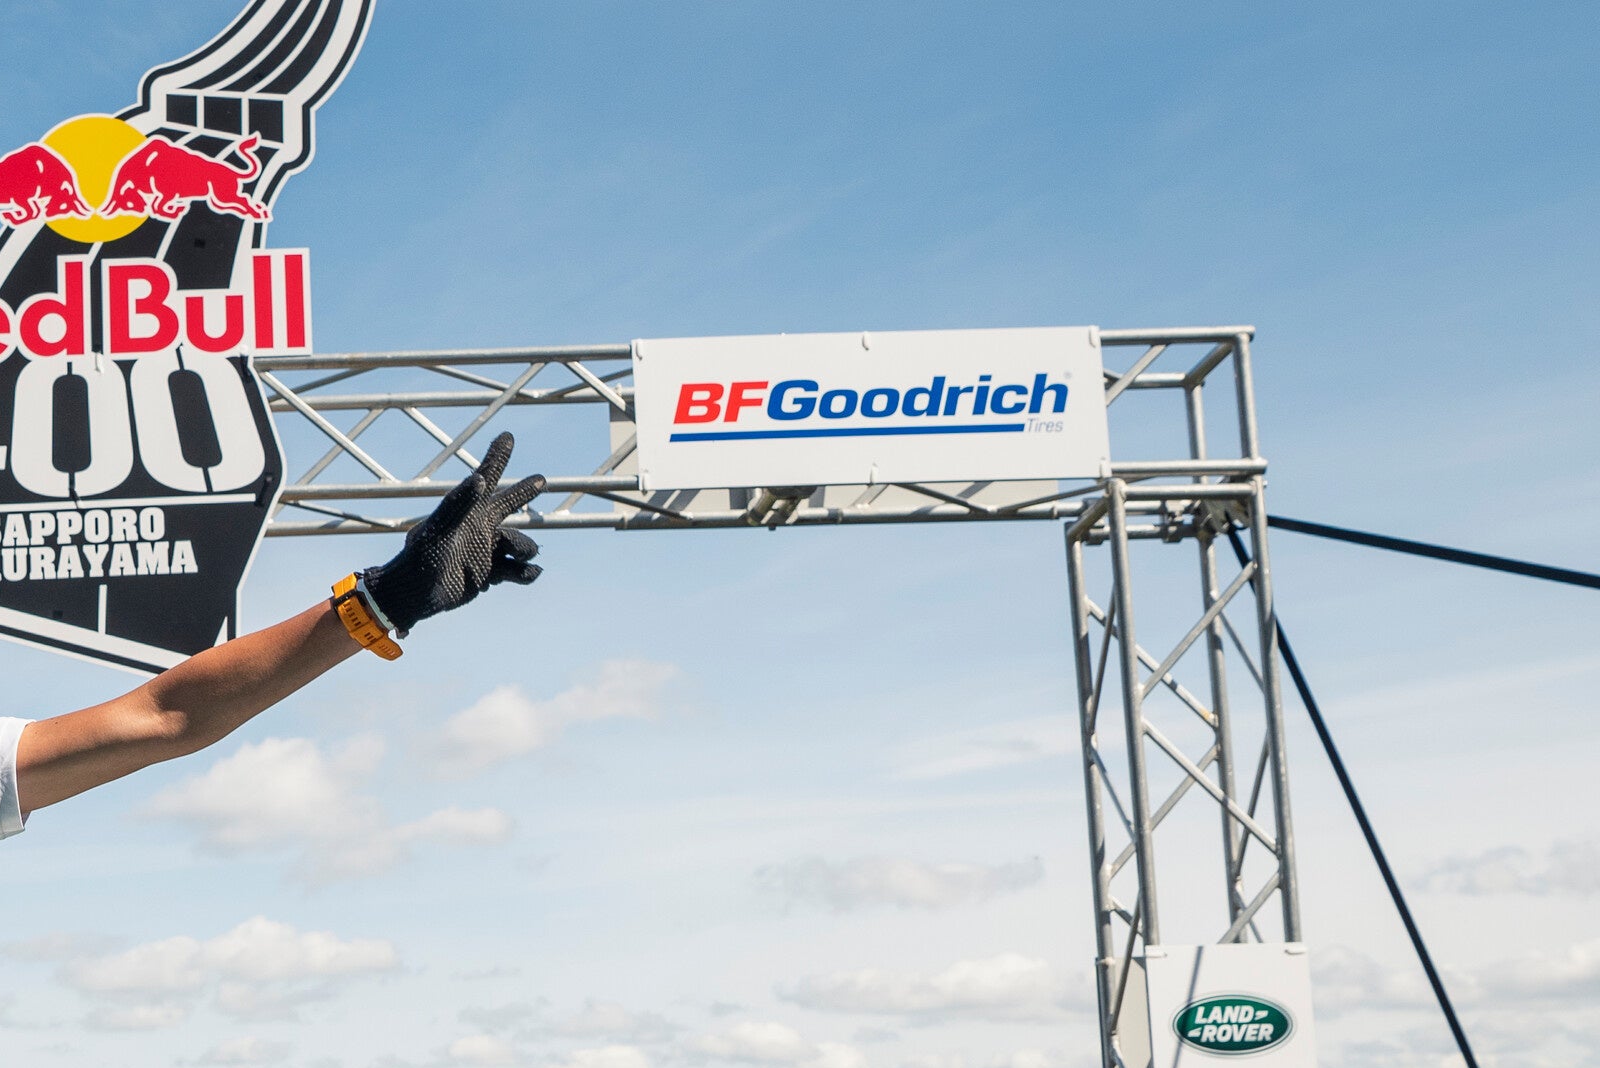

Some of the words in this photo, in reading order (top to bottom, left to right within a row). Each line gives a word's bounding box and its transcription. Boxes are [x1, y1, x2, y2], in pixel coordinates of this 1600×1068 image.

[108, 254, 306, 356] Bull
[673, 373, 1069, 425] BFGoodrich
[1026, 417, 1064, 434] Tires
[1194, 1005, 1255, 1024] LAND
[1201, 1023, 1275, 1043] ROVER
